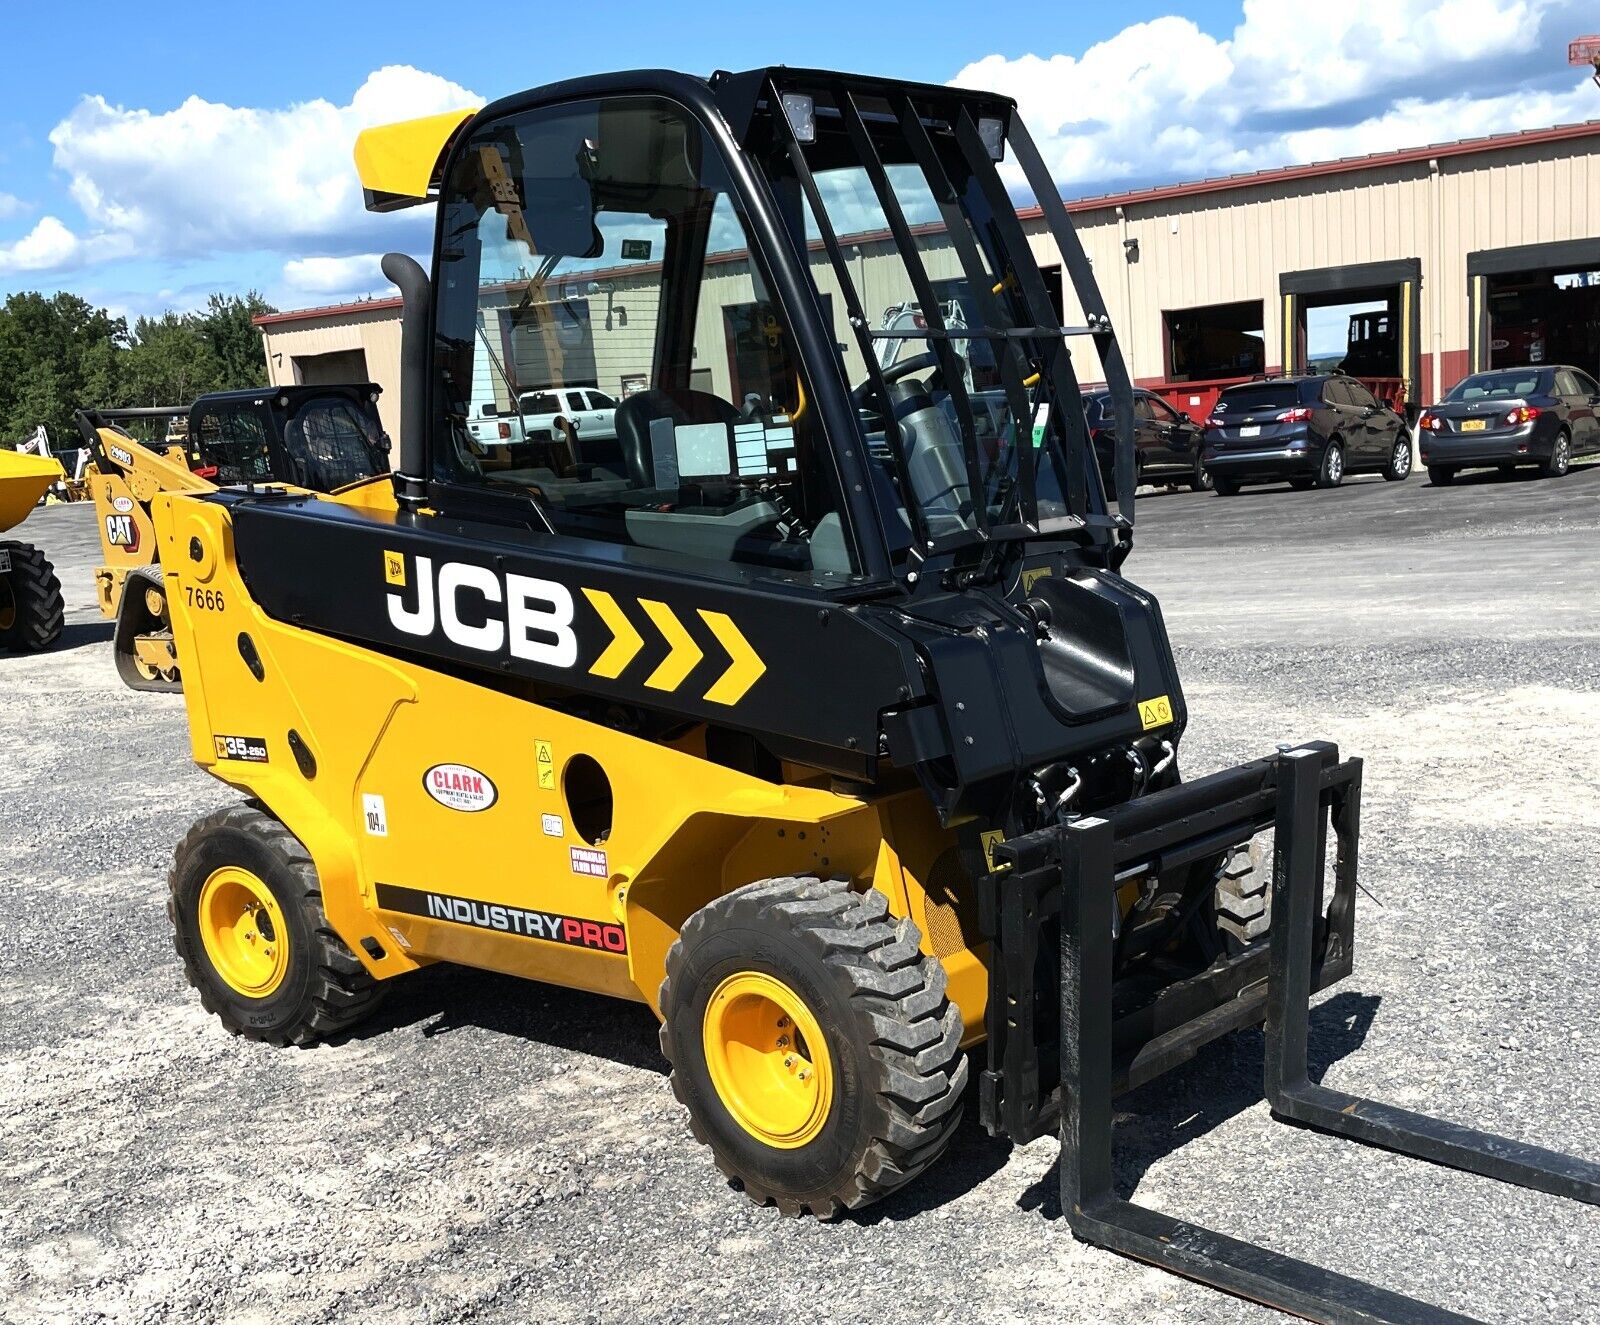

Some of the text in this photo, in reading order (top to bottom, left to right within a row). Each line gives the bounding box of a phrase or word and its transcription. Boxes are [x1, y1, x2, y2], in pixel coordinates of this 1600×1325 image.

[105, 515, 132, 545] CAT
[185, 586, 225, 612] 7666
[386, 555, 578, 668] JCB
[433, 770, 484, 795] CLARK
